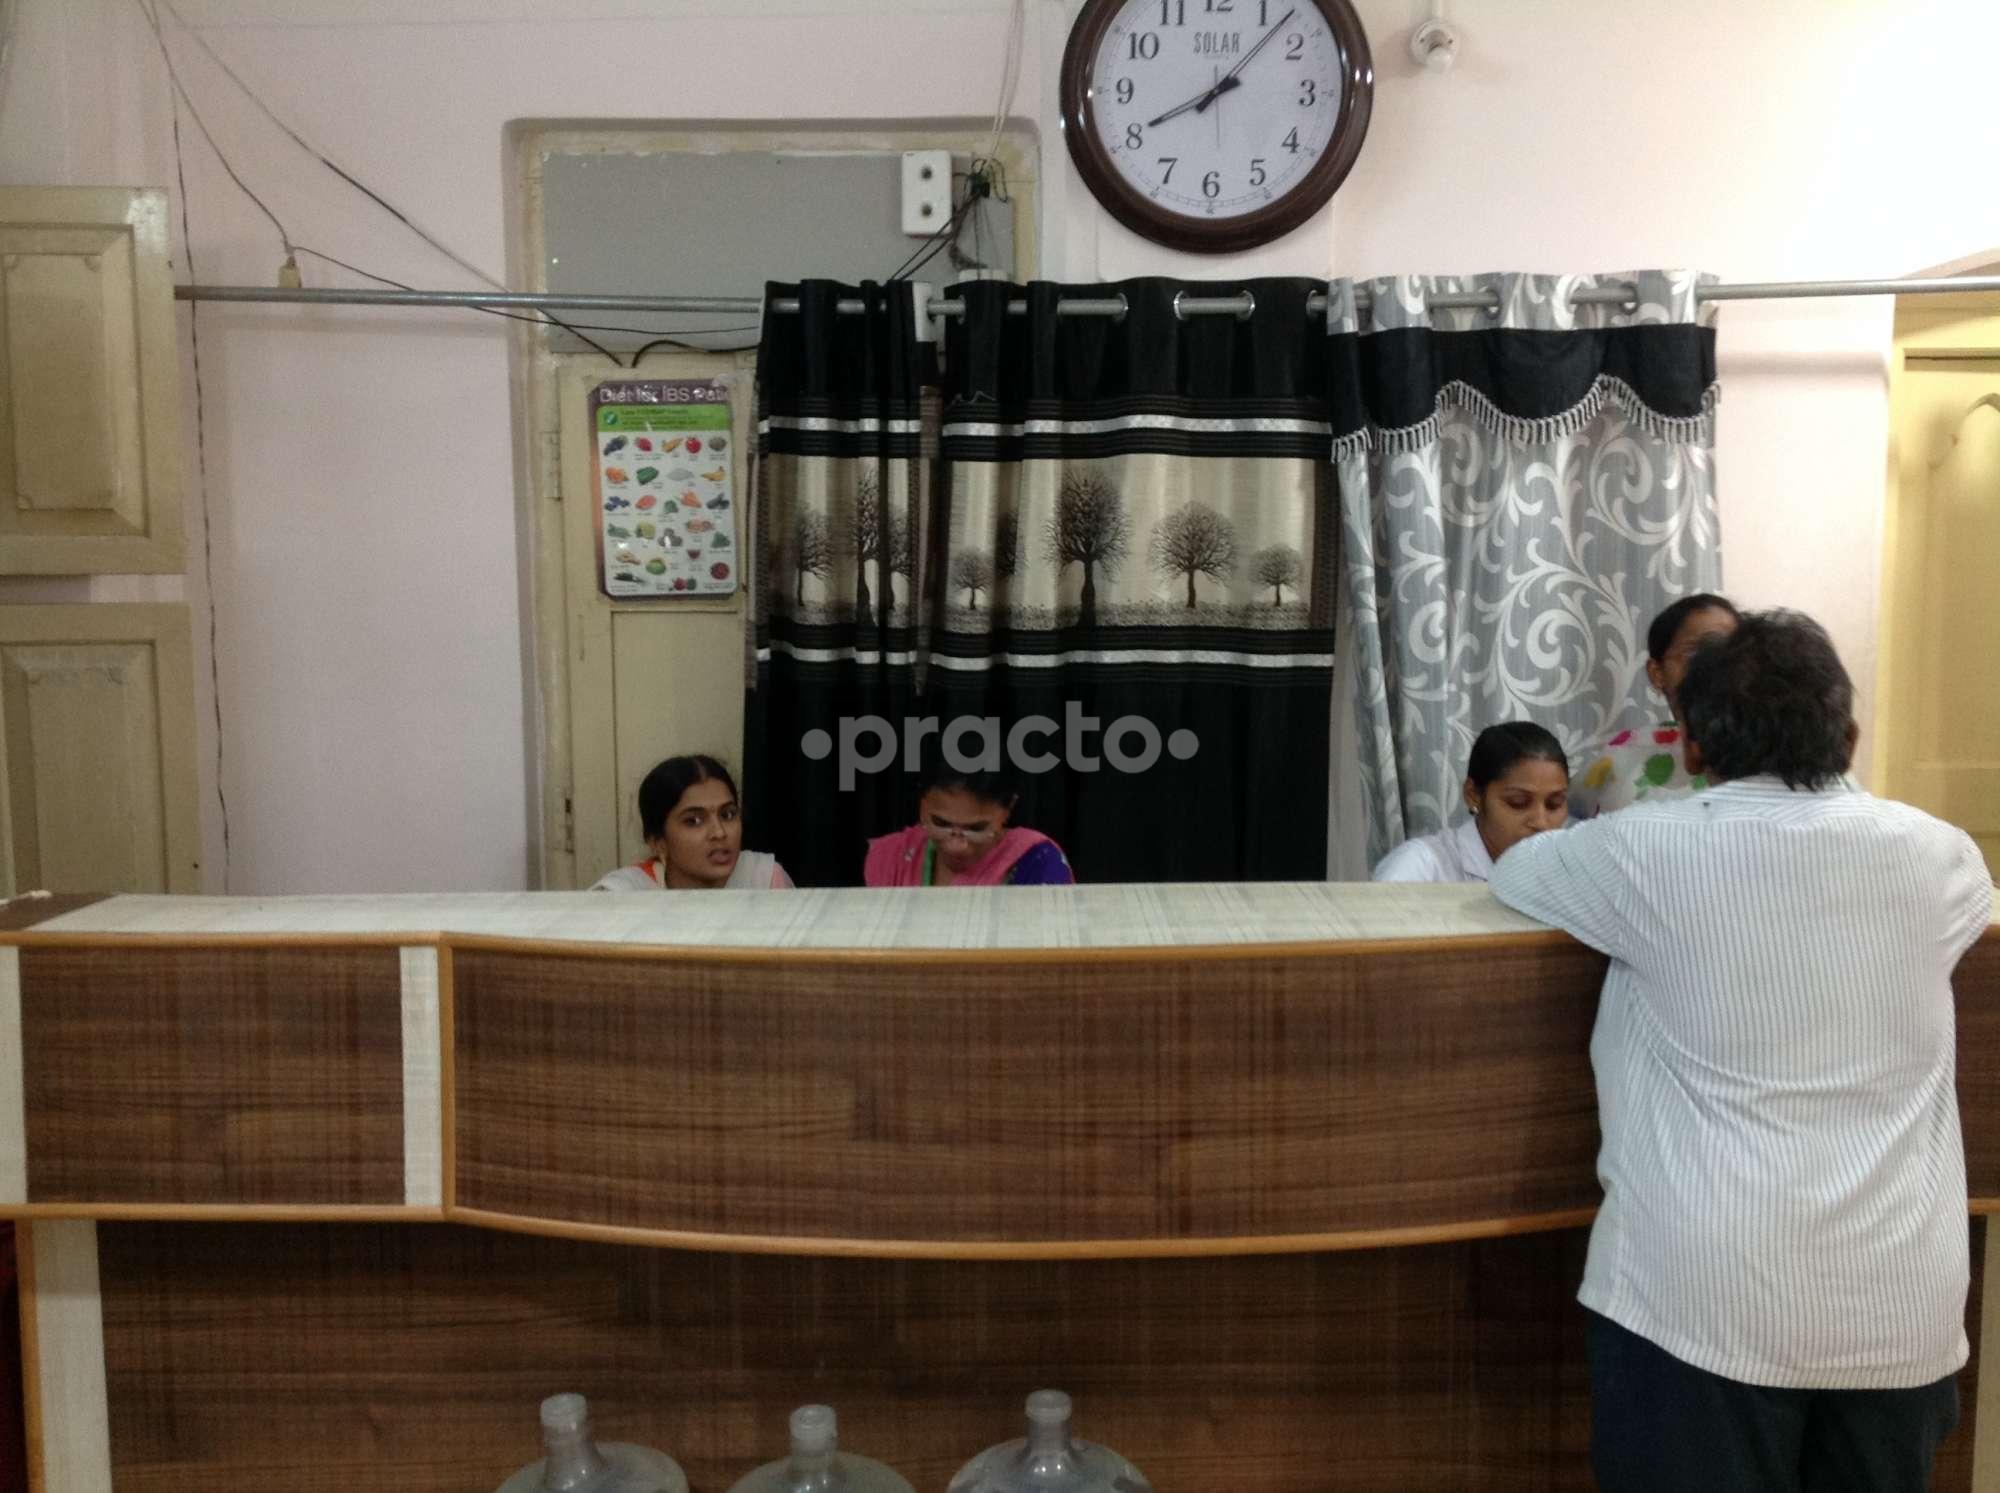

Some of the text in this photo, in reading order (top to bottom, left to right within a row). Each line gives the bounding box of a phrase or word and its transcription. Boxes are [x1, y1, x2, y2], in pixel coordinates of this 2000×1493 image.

[1160, 0, 1186, 26] 11
[1258, 0, 1268, 26] 1
[1128, 32, 1160, 60] 10
[1193, 31, 1240, 54] SOLAR
[1285, 33, 1304, 61] 2
[1116, 77, 1134, 105] 9
[1298, 79, 1316, 107] 3
[1125, 122, 1143, 150] 8
[1281, 126, 1301, 154] 4
[1157, 157, 1178, 185] 7
[1202, 171, 1220, 199] 6
[1249, 159, 1266, 187] 5
[662, 384, 690, 402] IBS
